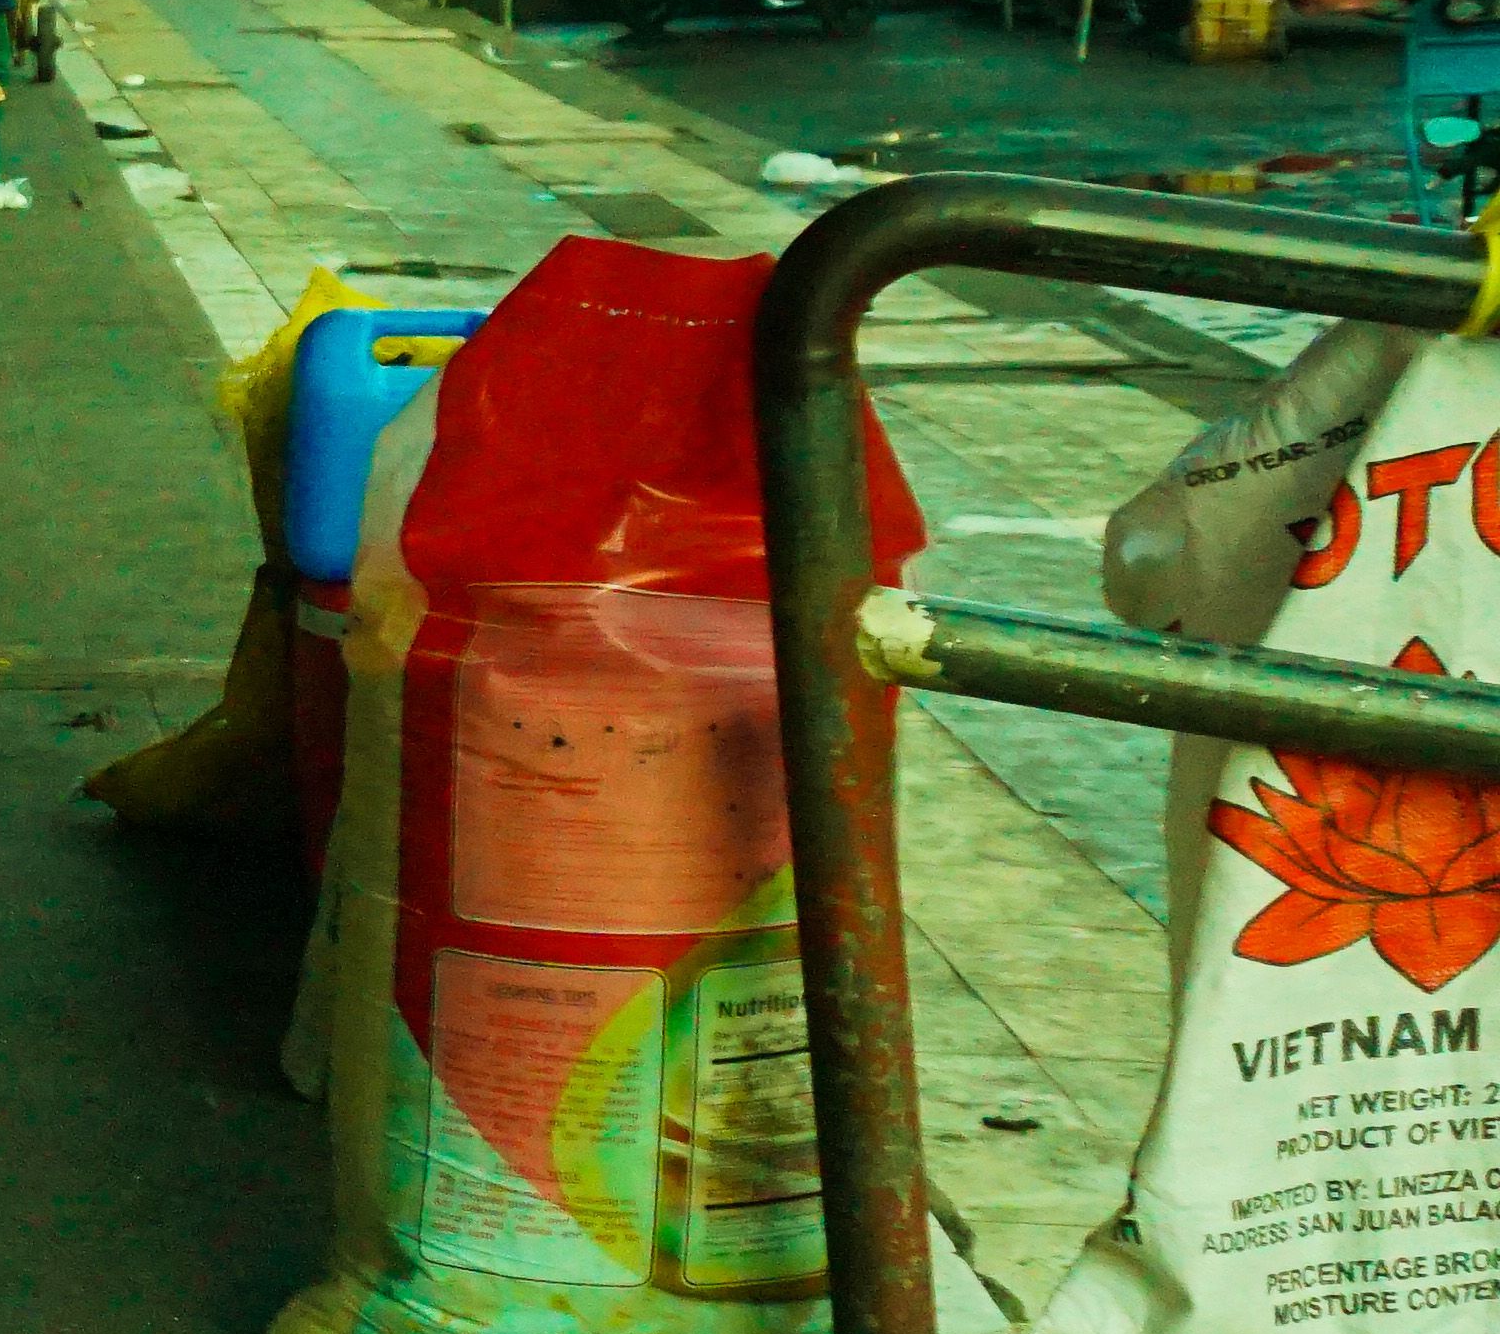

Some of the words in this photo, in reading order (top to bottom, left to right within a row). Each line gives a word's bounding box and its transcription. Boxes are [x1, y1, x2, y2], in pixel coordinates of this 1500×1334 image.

[1247, 440, 1317, 474] YEAR:
[1231, 1007, 1481, 1083] VIETNAM
[1297, 1094, 1341, 1124] NET
[1350, 1083, 1473, 1116] WEIGHT:
[1276, 1124, 1397, 1160] PRODUCT
[1407, 1121, 1443, 1146] OF
[1230, 1183, 1318, 1221] IMPORTED
[1325, 1178, 1370, 1202] BY:
[1376, 1168, 1480, 1200] LINEZZA
[1299, 1211, 1345, 1238] SAN
[1352, 1205, 1422, 1234] JUAN
[1266, 1255, 1428, 1296] PERCENTAGE
[1272, 1289, 1399, 1327] MOISTURE
